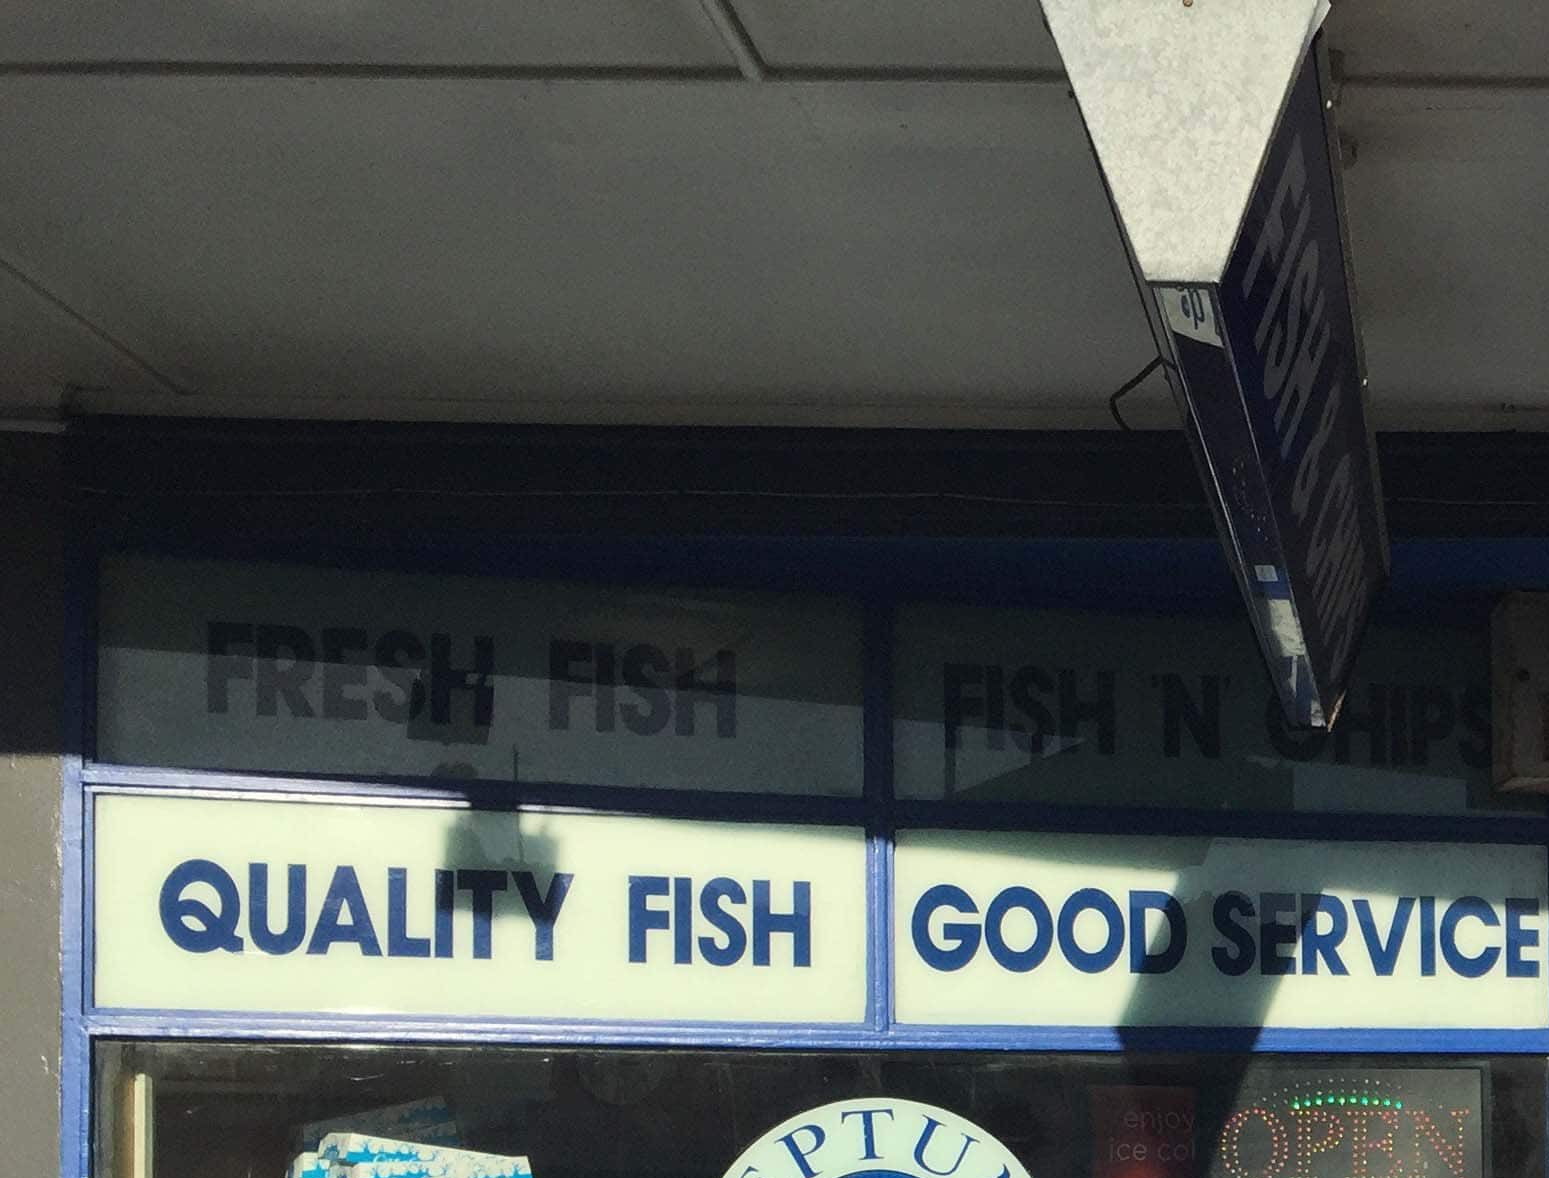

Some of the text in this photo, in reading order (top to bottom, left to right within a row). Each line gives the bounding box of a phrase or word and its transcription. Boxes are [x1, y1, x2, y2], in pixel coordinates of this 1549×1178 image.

[1242, 130, 1332, 462] FISH
[204, 621, 737, 738] FRESH FISH
[944, 662, 1116, 757] FISH
[158, 857, 812, 968] QUALITY FISH
[911, 883, 1541, 980] GOOD SERVICE
[1110, 1138, 1196, 1161] ice col
[1123, 1111, 1195, 1136] enjoy
